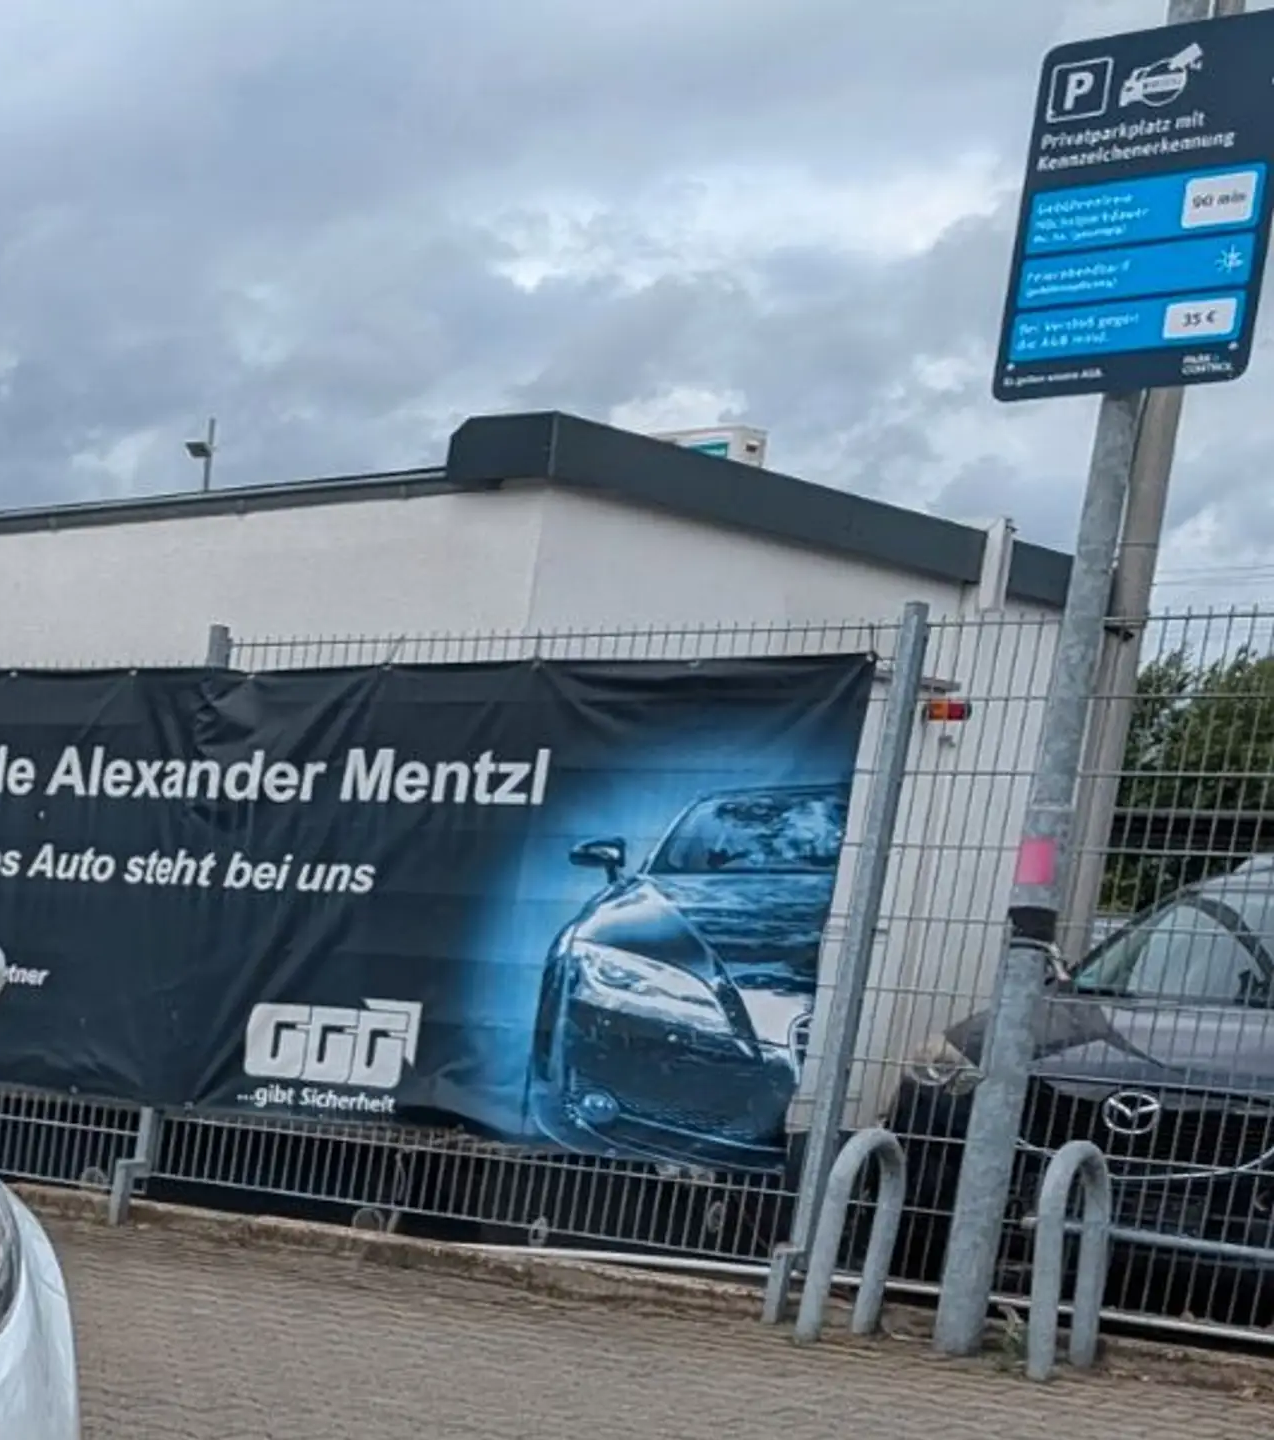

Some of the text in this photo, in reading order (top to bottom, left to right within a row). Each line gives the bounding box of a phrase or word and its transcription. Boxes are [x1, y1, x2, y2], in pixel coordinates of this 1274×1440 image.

[1063, 71, 1094, 111] P
[1041, 110, 1205, 149] Privatparkplatz mit
[1036, 132, 1236, 171] Kennzeichenerkennung
[46, 745, 327, 803] Alexander
[340, 748, 551, 806] Mentzl
[26, 844, 116, 882] Auto
[123, 848, 216, 888] steht
[223, 851, 293, 891] bei
[297, 863, 376, 894] uns
[5, 964, 50, 986] tner
[244, 1001, 413, 1089] GGG
[299, 1087, 396, 1113] Sicherheit
